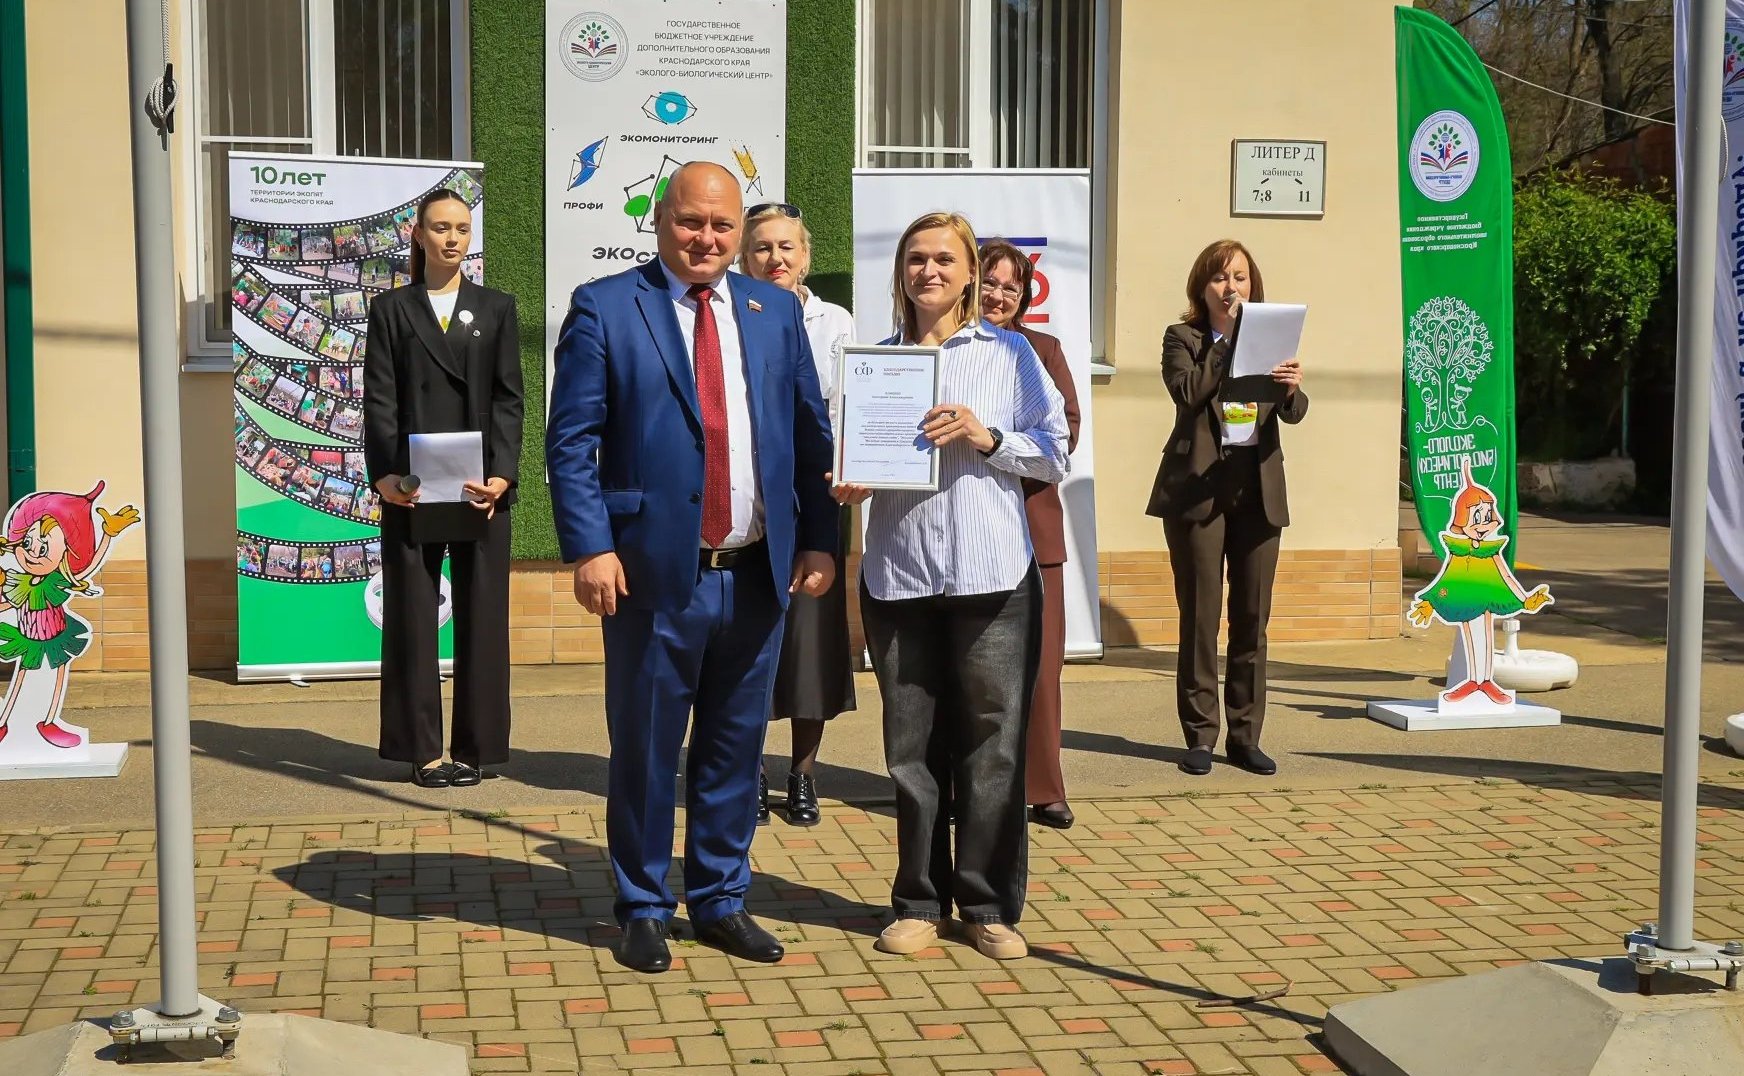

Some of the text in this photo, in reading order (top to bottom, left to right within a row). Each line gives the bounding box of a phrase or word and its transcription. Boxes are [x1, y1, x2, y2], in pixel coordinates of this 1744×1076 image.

[666, 20, 741, 30] ГОСУДАРСТВЕННОЕ
[654, 32, 754, 42] БЮДЖЕТНОЕ УЧРЕЖДЕНИЕ
[637, 44, 771, 55] ДОПОЛНИТЕЛЬНОГО ОБРАЗОВАНИЯ
[658, 57, 730, 66] КРАСНОДАРСКОГО
[635, 69, 774, 81] «ЭКОЛОГО-БИОЛОГИЧЕСКИЙ ЦЕНТР»
[620, 134, 719, 145] ЭКОМОНИТОРИНГ
[1251, 146, 1316, 162] ЛИТЕР Д
[250, 166, 327, 186] 10 лет
[1262, 168, 1303, 177] кабинеты
[250, 189, 295, 197] ТЕРРИТОРИИ
[1252, 190, 1311, 203] 7;8 11
[250, 197, 314, 205] КРАСНОДАРСКОГО
[563, 201, 604, 211] ПРОФИ
[592, 246, 659, 264] ЭКОС
